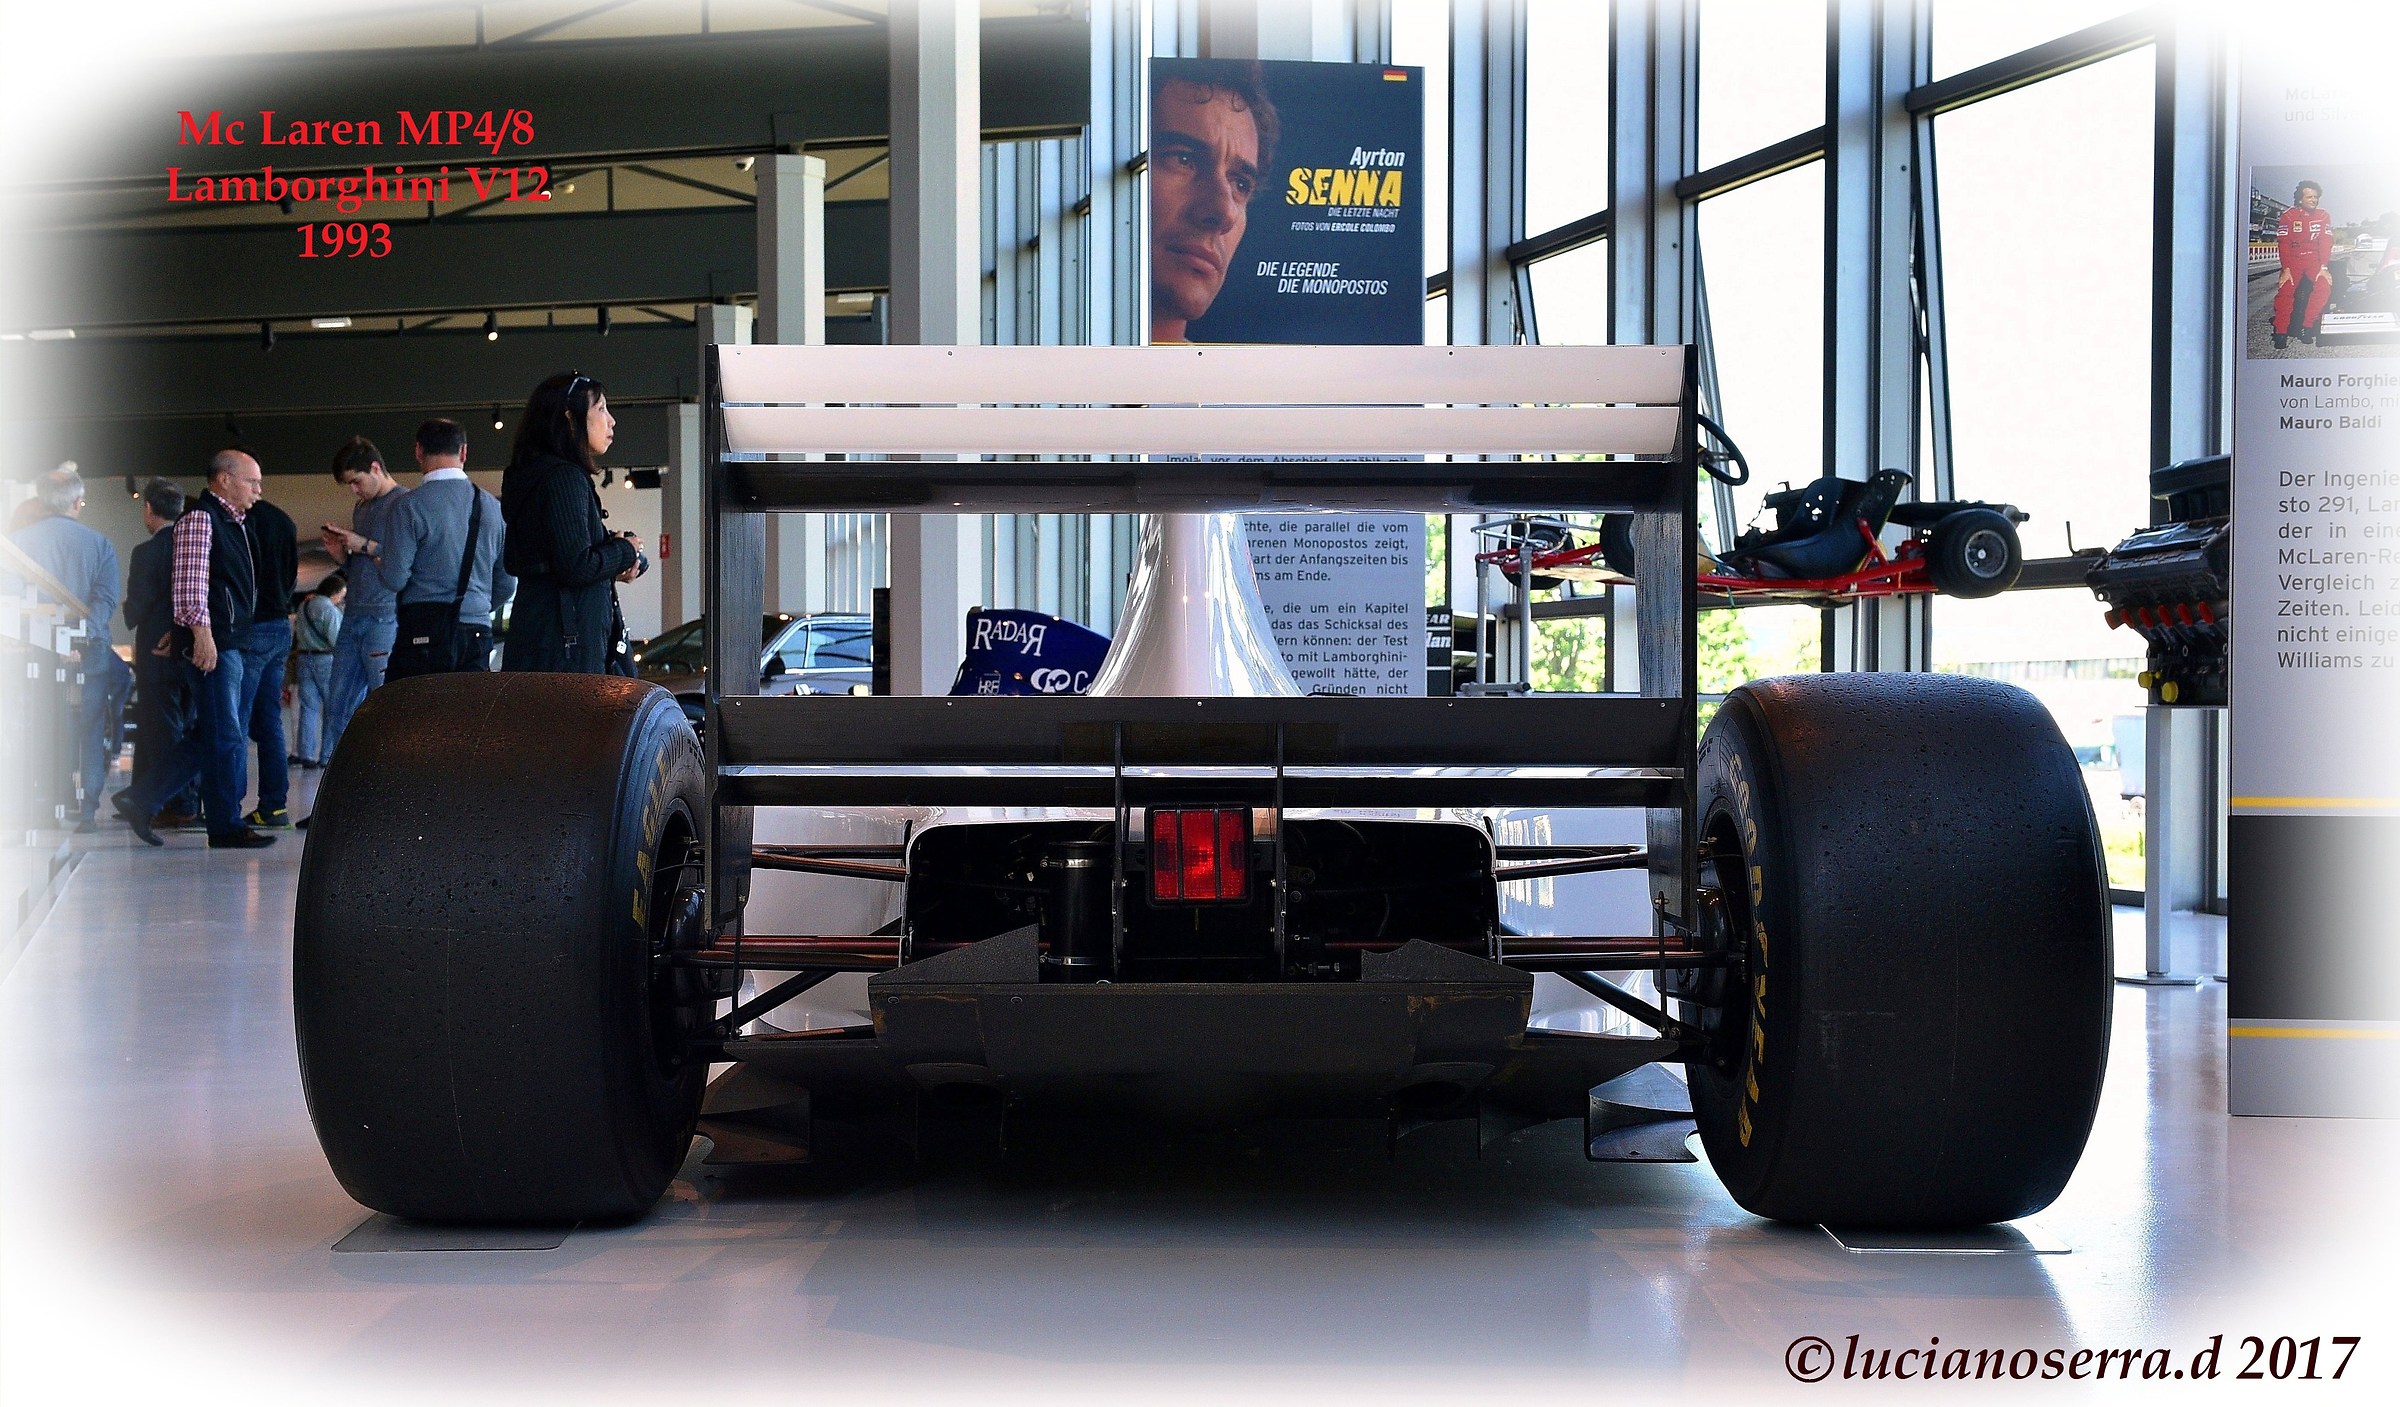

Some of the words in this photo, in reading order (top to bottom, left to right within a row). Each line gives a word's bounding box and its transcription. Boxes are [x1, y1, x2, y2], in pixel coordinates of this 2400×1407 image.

[2284, 109, 2314, 122] und
[1350, 146, 1405, 170] Ayrton
[1285, 168, 1403, 207] SENNA
[1328, 207, 1342, 217] DIE
[1343, 207, 1372, 218] LETZTE
[1372, 208, 1400, 218] NACHT
[1291, 221, 1315, 231] FOTOS
[1315, 222, 1331, 231] VON
[1331, 222, 1360, 232] ERCOLE
[1360, 223, 1396, 233] COLOMBO
[1257, 261, 1280, 277] DIE
[1281, 261, 1340, 278] LEGENDE
[1278, 278, 1300, 293] DIE
[1301, 279, 1389, 295] MONOPOSTOS
[2280, 374, 2332, 388] Mauro
[2280, 397, 2309, 409] von
[2315, 394, 2374, 411] Lambo,
[2380, 394, 2400, 409] mi
[2280, 416, 2332, 430] Mauro
[2339, 415, 2382, 429] Baldi
[2279, 471, 2315, 487] Der
[2324, 470, 2400, 490] Ingenie
[2278, 496, 2310, 512] sto
[2318, 496, 2360, 515] 291,
[1244, 521, 1272, 533] chte,
[1279, 521, 1298, 533] die
[1305, 521, 1350, 535] parallel
[1357, 521, 1376, 533] die
[1383, 524, 1408, 532] vom
[2278, 523, 2313, 538] der
[2329, 523, 2346, 538] in
[2363, 523, 2400, 538] eine
[1294, 538, 1368, 550] Monopostos
[1375, 538, 1408, 551] zeigt,
[1275, 554, 1295, 565] der
[1300, 554, 1387, 567] Anfangszeiten
[1391, 554, 1408, 565] bis
[2278, 549, 2400, 565] McLaren-Re
[1274, 572, 1293, 581] am
[1297, 570, 1331, 581] Ende.
[2279, 574, 2375, 594] Vergleich
[1283, 603, 1301, 613] die
[1310, 605, 1329, 613] um
[1338, 603, 1356, 613] ein
[1365, 603, 1408, 615] Kapitel
[2277, 600, 2350, 616] Zeiten.
[1271, 619, 1293, 630] das
[1298, 619, 1319, 630] das
[1324, 619, 1382, 630] Schicksal
[1387, 619, 1408, 630] des
[1303, 635, 1352, 646] können:
[1357, 635, 1377, 646] der
[1383, 635, 1408, 646] Test
[2277, 626, 2329, 642] nicht
[1298, 651, 1318, 662] mit
[1323, 651, 1408, 664] Lamborghini-
[2277, 651, 2363, 668] Williams
[2371, 655, 2394, 668] zu
[1291, 667, 1335, 680] gewollt
[1344, 667, 1380, 680] hätte,
[1388, 668, 1408, 679] der
[1312, 683, 1366, 695] Gründen
[1376, 683, 1408, 695] nicht
